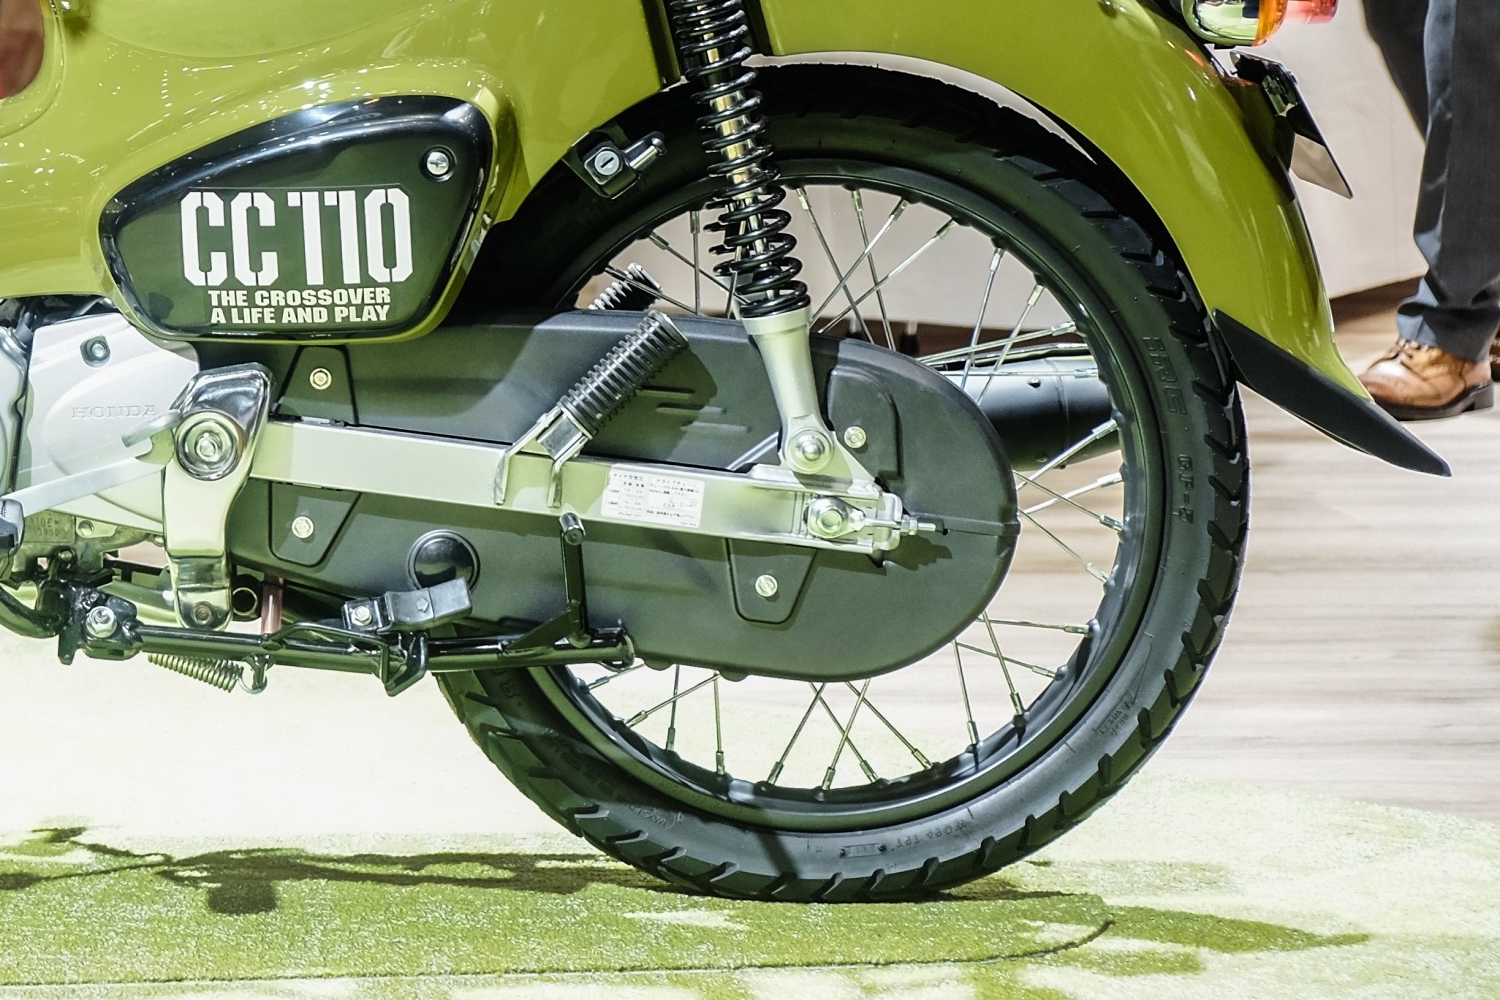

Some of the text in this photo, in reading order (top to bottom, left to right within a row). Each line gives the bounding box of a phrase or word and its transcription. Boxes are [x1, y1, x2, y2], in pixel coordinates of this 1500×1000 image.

[207, 287, 392, 307] THE CROSSOVER
[210, 305, 390, 324] A LIFE AND PLAY
[70, 405, 158, 420] HONDA
